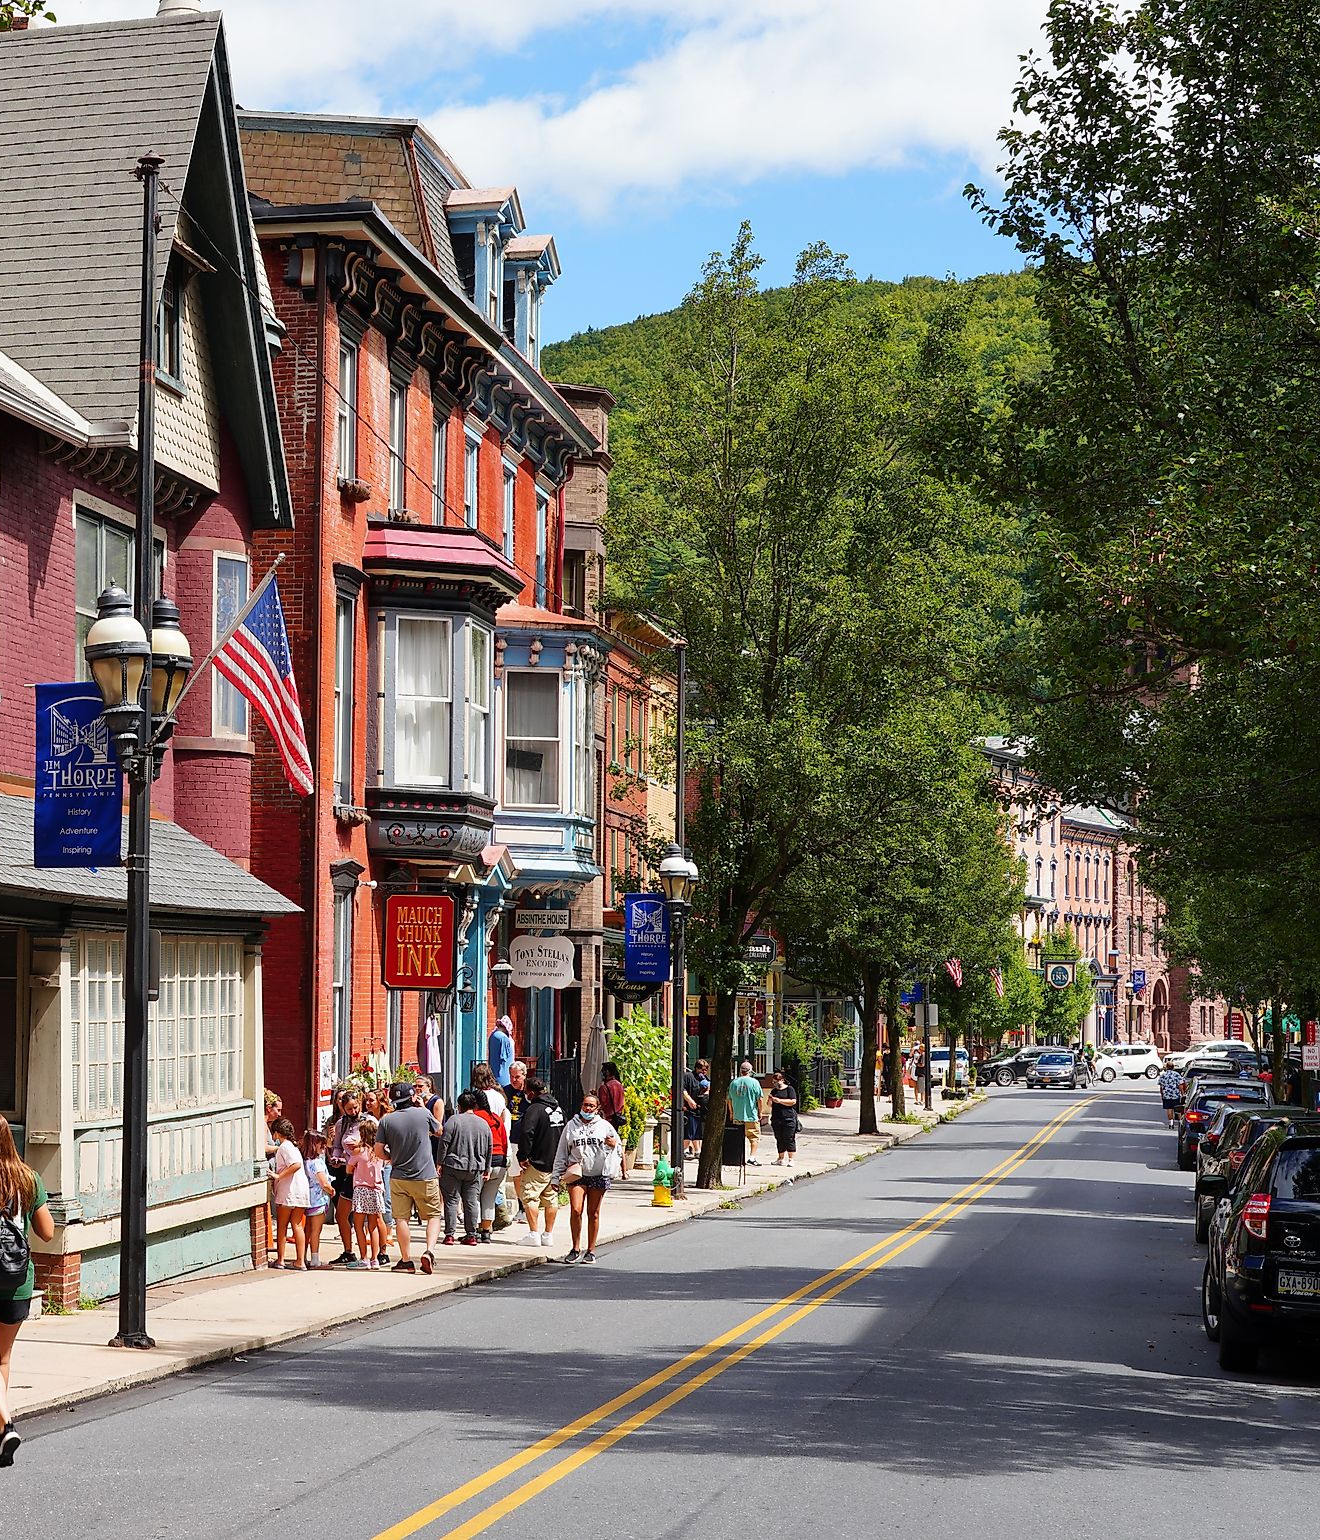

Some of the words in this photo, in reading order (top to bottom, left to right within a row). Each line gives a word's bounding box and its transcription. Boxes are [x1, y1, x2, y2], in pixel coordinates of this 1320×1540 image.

[43, 760, 61, 772] JIM
[48, 761, 116, 791] THORPE
[67, 807, 91, 817] History
[59, 827, 98, 835] Adventure
[62, 846, 92, 855] Inspiring
[397, 906, 443, 924] MAUCH
[517, 914, 546, 924] ABSINTHE
[547, 914, 568, 925] HOUSE
[396, 924, 442, 943] CHUNK
[632, 930, 666, 944] THORPE
[747, 944, 772, 953] ault
[396, 944, 442, 977] INK
[515, 948, 535, 962] TONY
[526, 960, 558, 968] ENCORE
[614, 981, 647, 991] House
